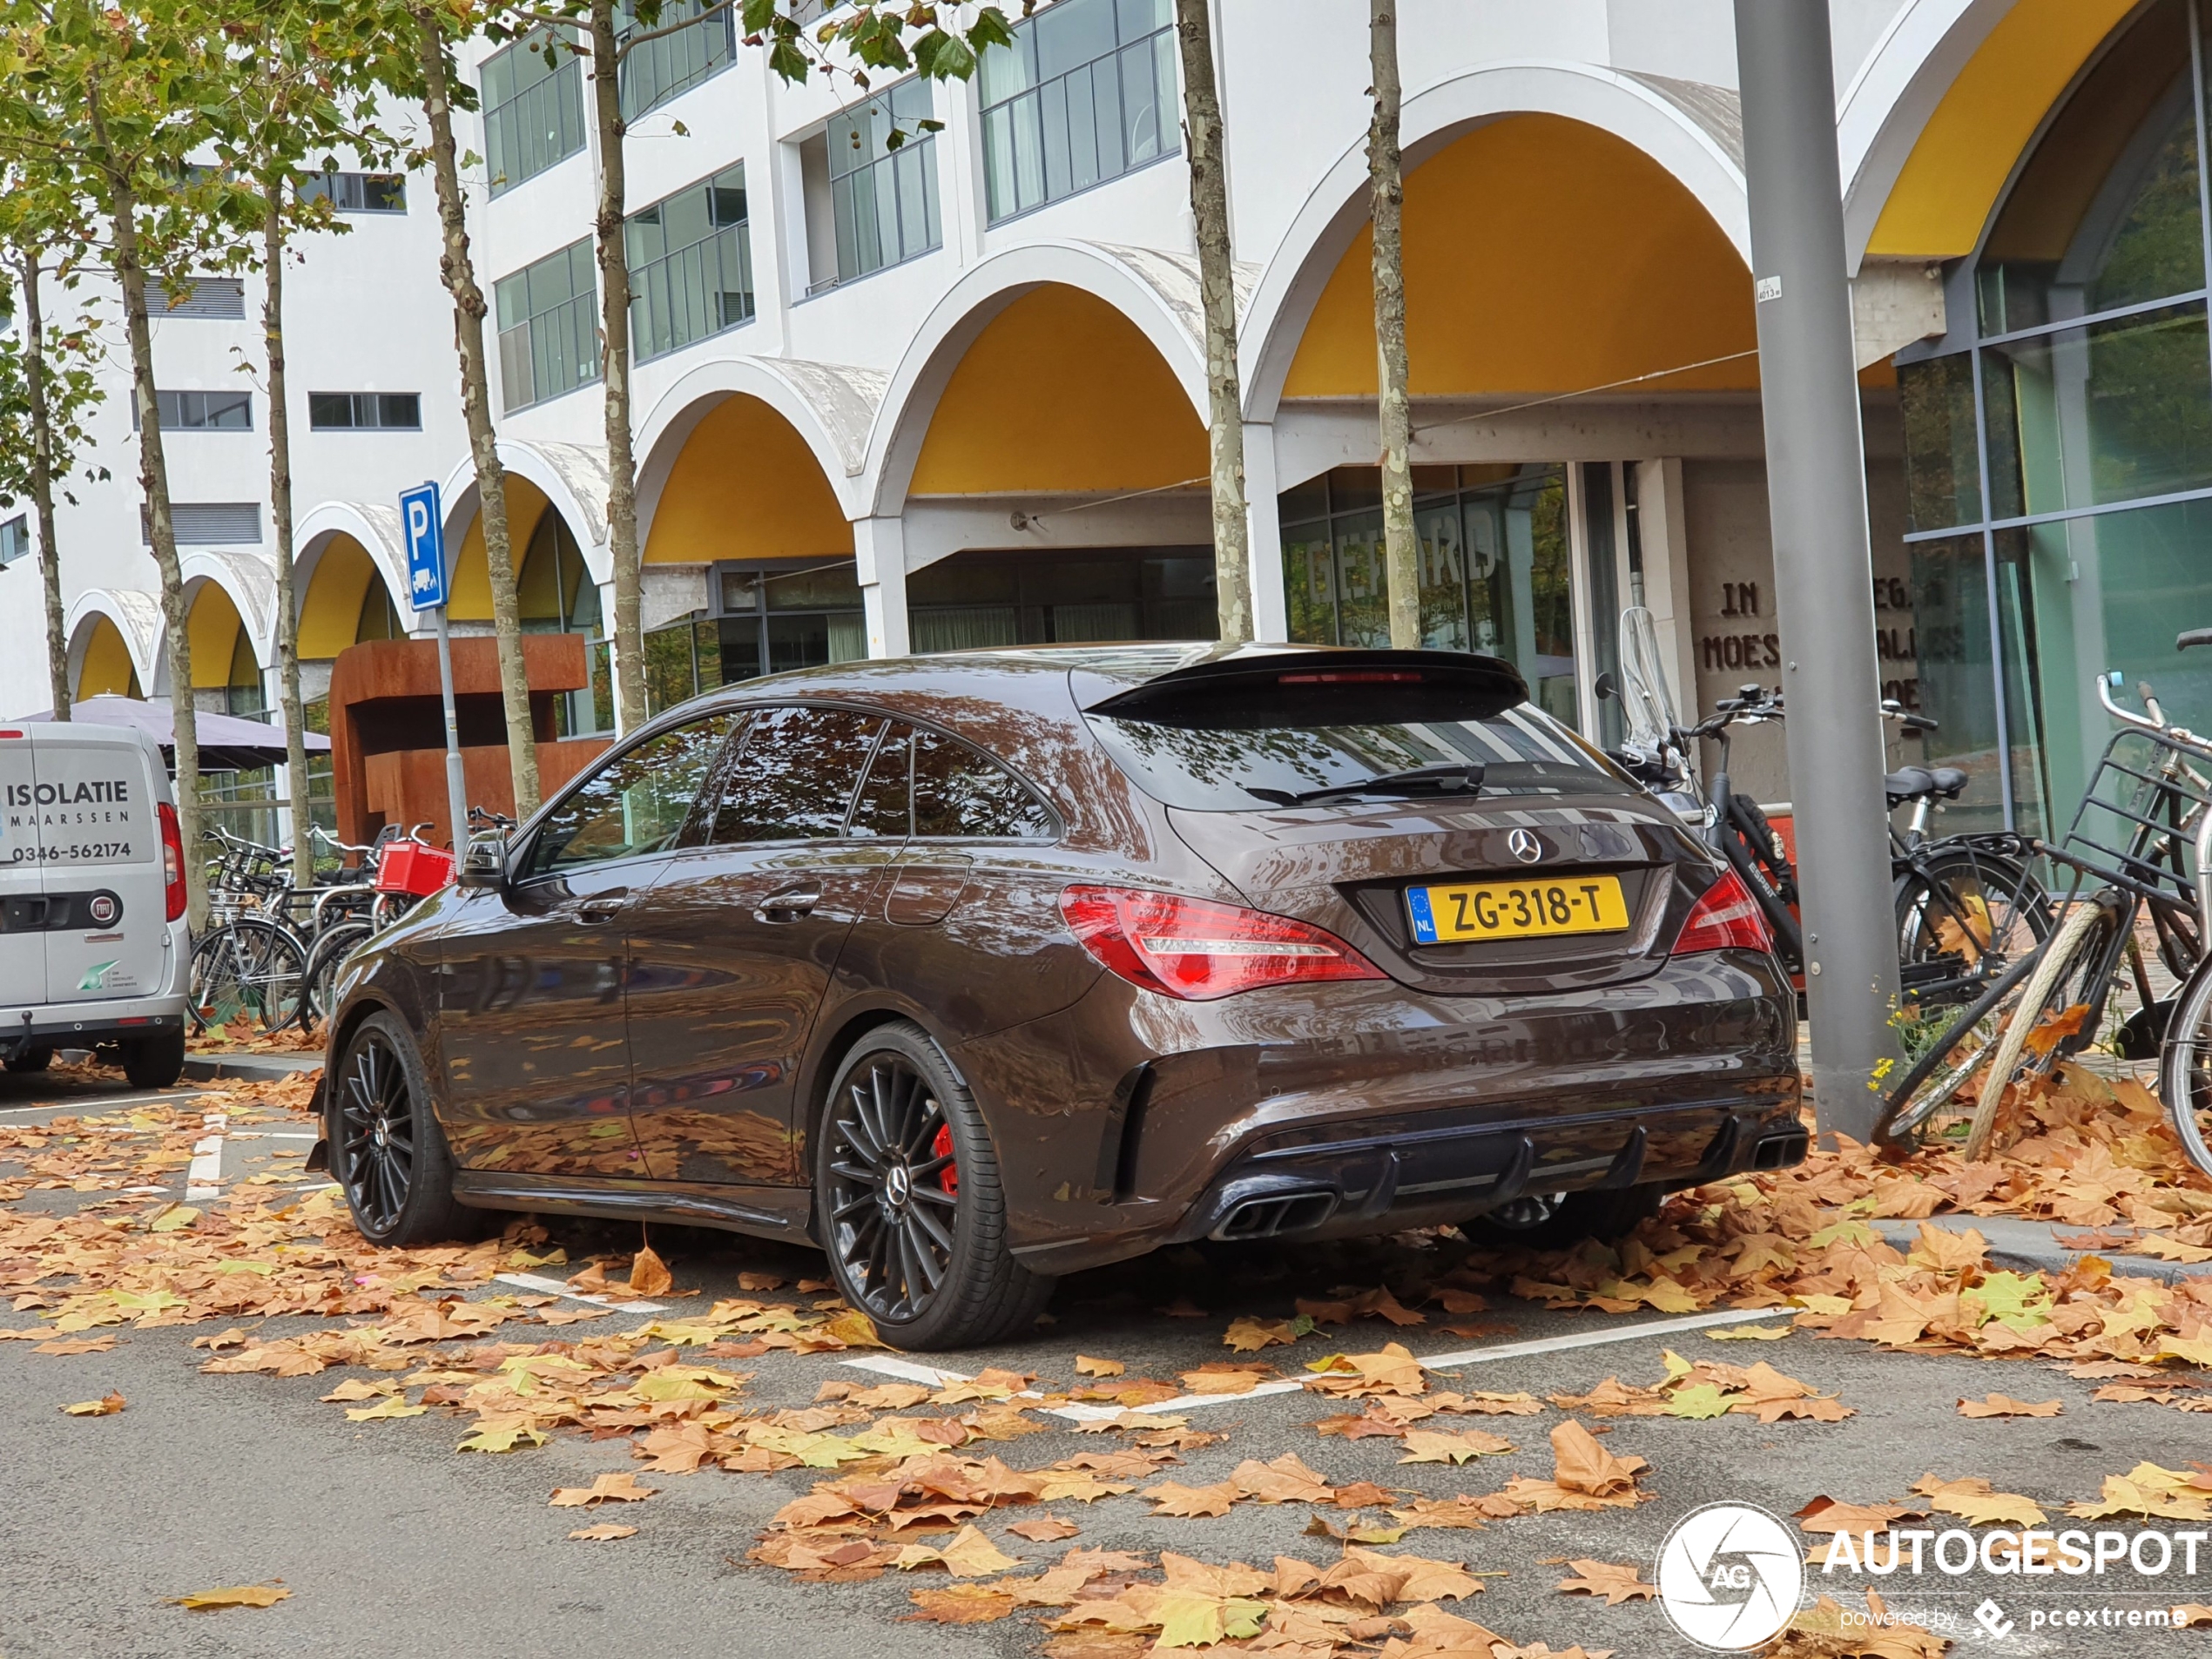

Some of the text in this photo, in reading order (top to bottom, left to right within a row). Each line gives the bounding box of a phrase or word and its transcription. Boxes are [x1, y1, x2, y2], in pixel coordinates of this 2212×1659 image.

[408, 500, 428, 561] P
[1721, 581, 1759, 615] IN
[7, 781, 129, 806] ISOLATIE
[10, 811, 129, 827] MAARSSEN
[12, 842, 132, 862] 0346-562174
[96, 903, 111, 915] FIAT
[1449, 885, 1601, 932] ZG-318-T
[1416, 920, 1433, 933] NL
